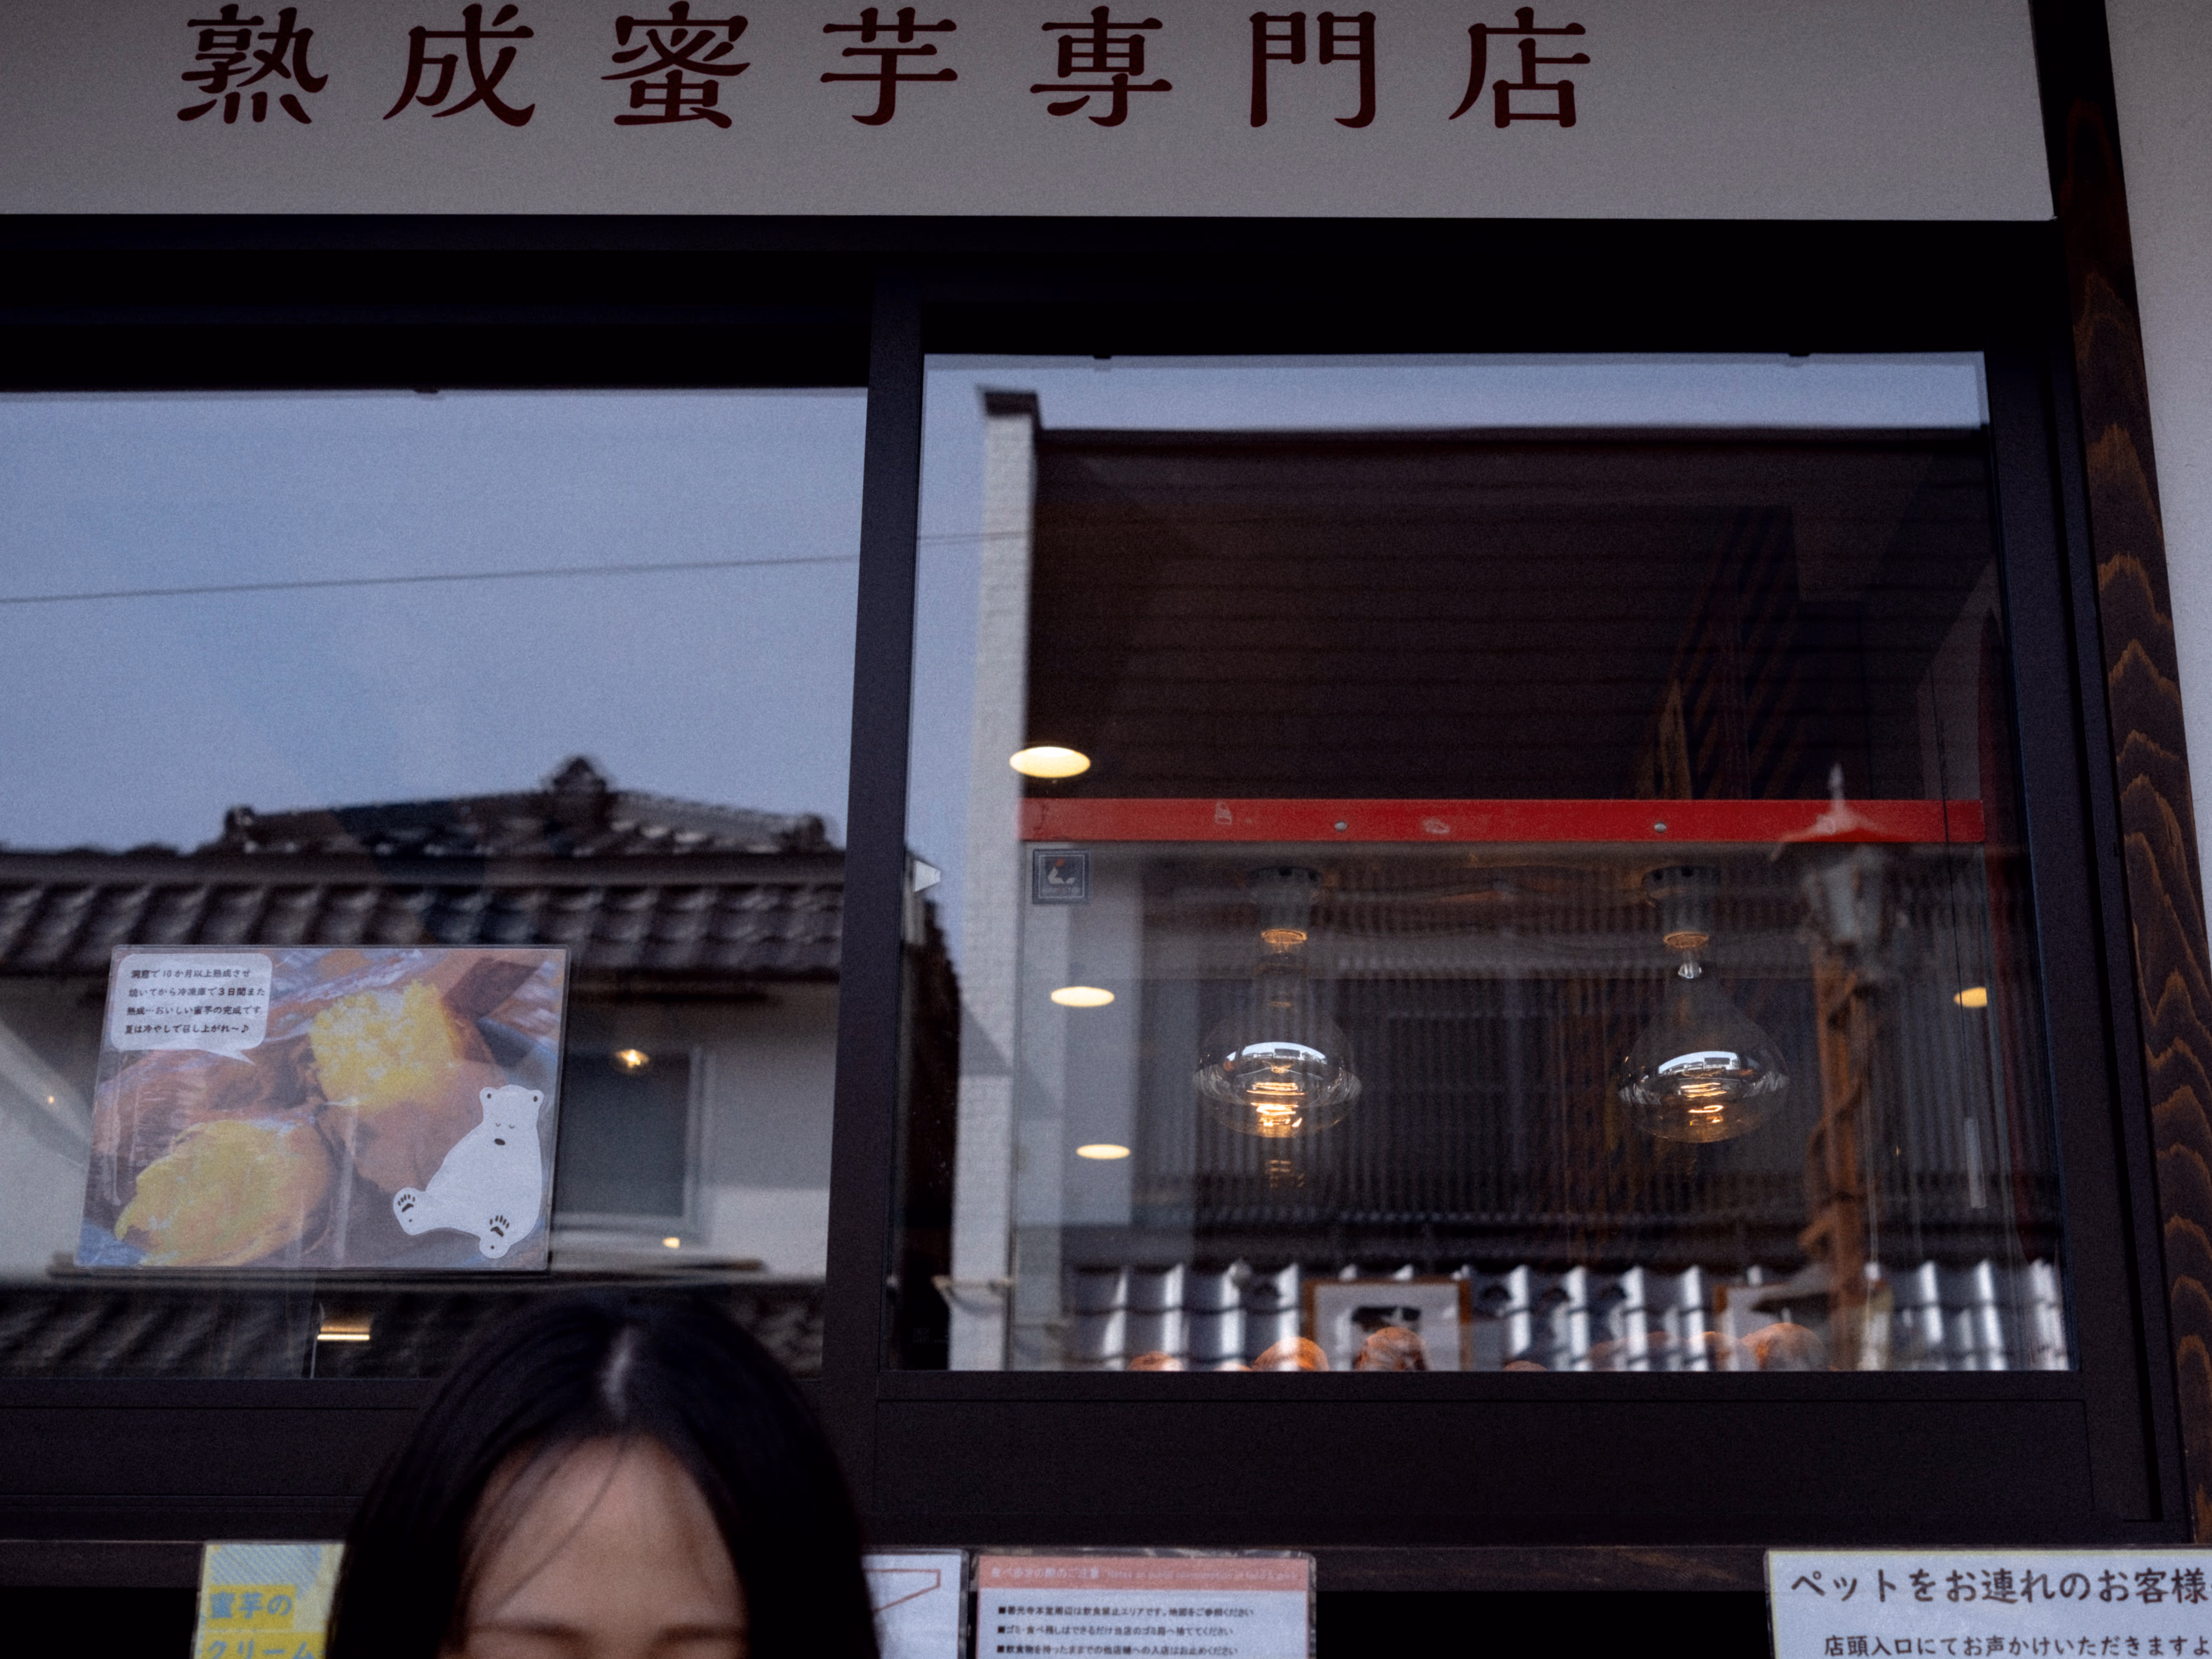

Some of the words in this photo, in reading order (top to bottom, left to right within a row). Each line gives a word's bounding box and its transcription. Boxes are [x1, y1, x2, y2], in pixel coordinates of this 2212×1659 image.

[177, 1, 1591, 129] 熟成蜜芋専門店
[1791, 1567, 2212, 1605] ペットをお連れのお客様
[1825, 1634, 2210, 1657] 店頭入口にてお声かけいただきますよ
